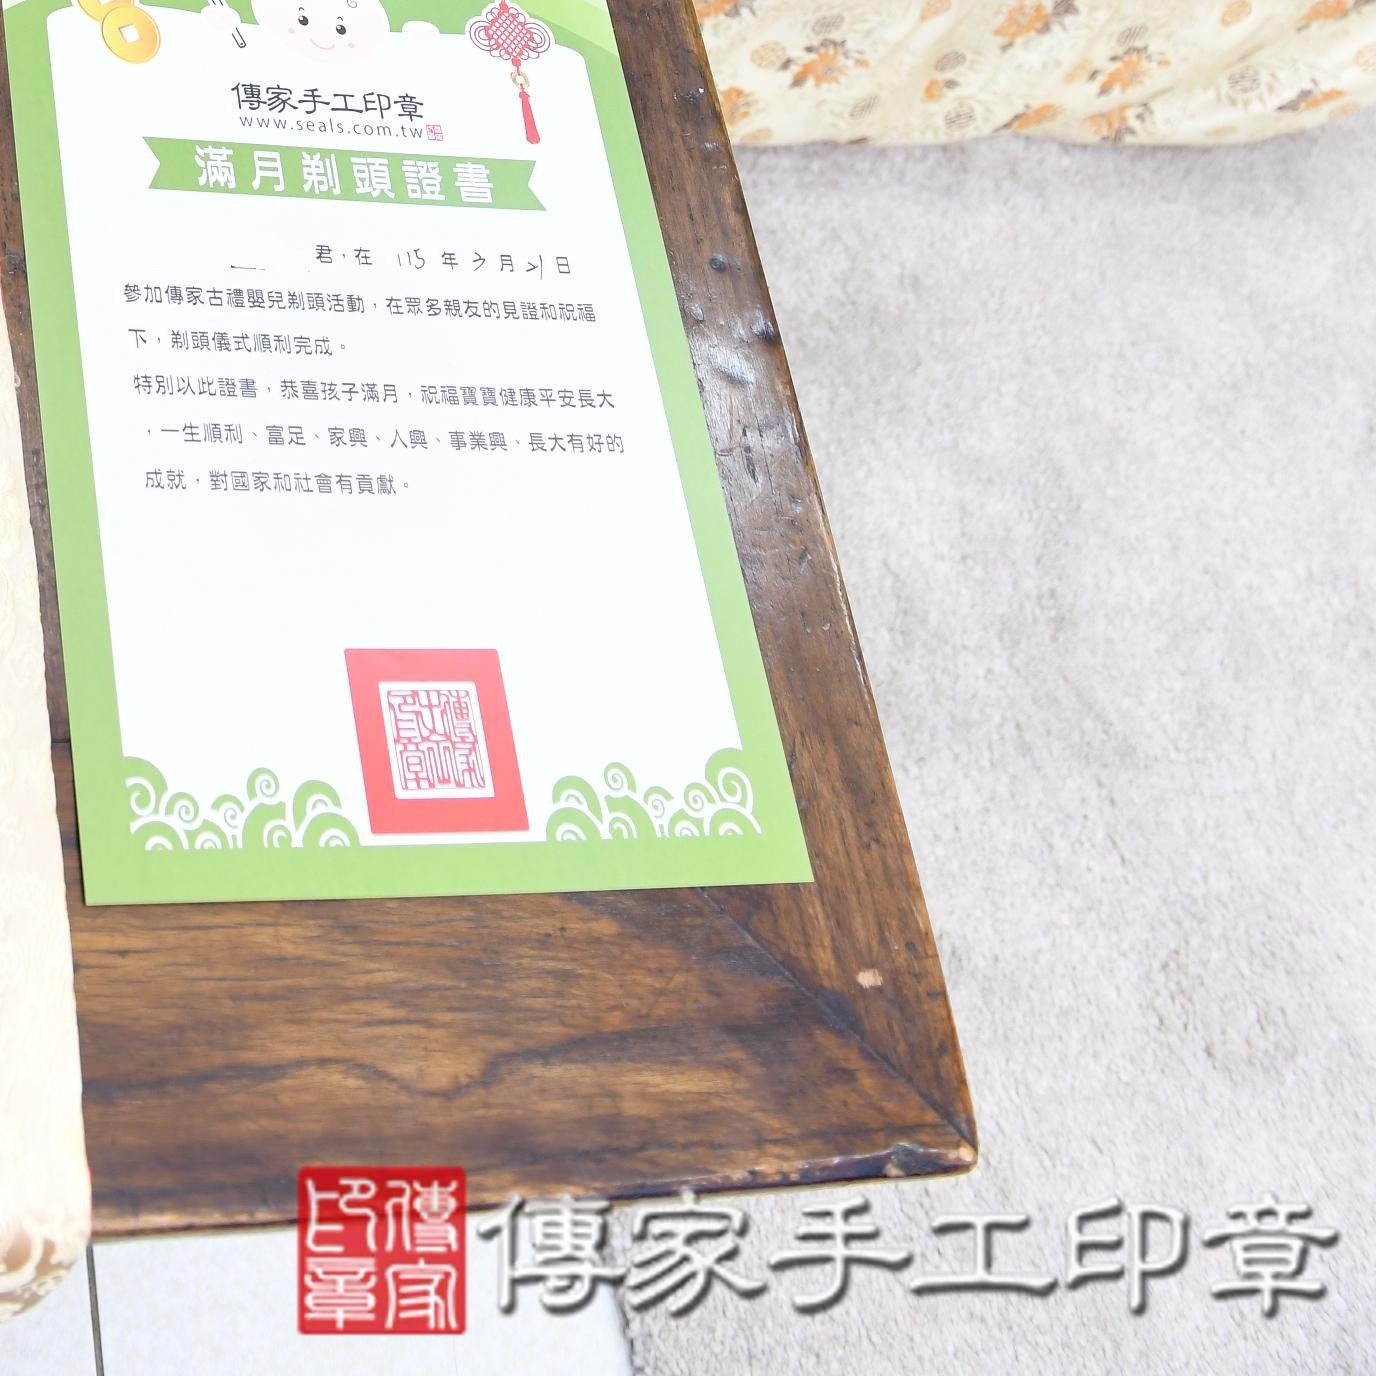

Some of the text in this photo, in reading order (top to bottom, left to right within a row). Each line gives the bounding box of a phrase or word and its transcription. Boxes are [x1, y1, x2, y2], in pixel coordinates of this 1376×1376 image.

[231, 82, 424, 122] 傳家手工印章
[239, 116, 423, 139] www.seals.com.tw
[194, 145, 494, 204] 滿月剃頭證書
[442, 251, 459, 270] 年
[500, 255, 514, 272] 月
[556, 257, 571, 274] 日
